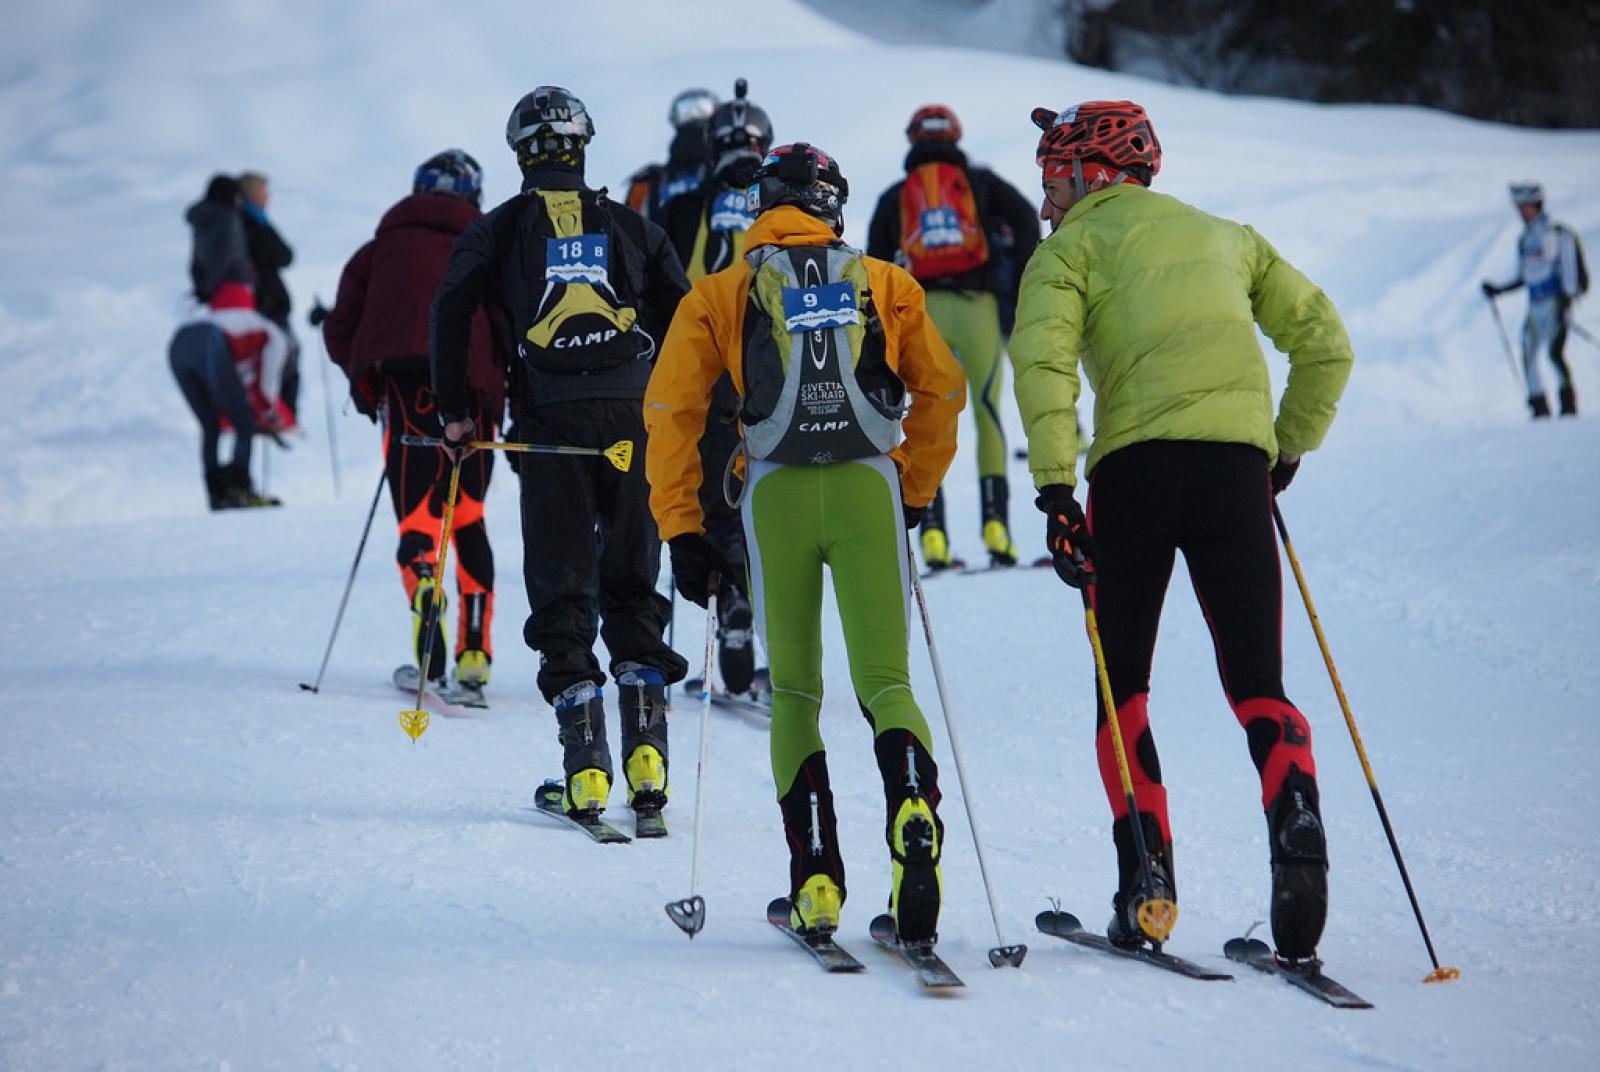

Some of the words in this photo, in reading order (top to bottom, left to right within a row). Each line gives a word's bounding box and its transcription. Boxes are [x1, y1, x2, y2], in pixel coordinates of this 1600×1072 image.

[552, 199, 576, 208] CAMP
[558, 241, 582, 259] 18
[594, 246, 604, 257] B
[802, 293, 818, 307] 9
[840, 292, 851, 303] A
[554, 329, 618, 349] CAMP
[801, 381, 845, 392] CIVETTA
[799, 421, 849, 432] CAMP
